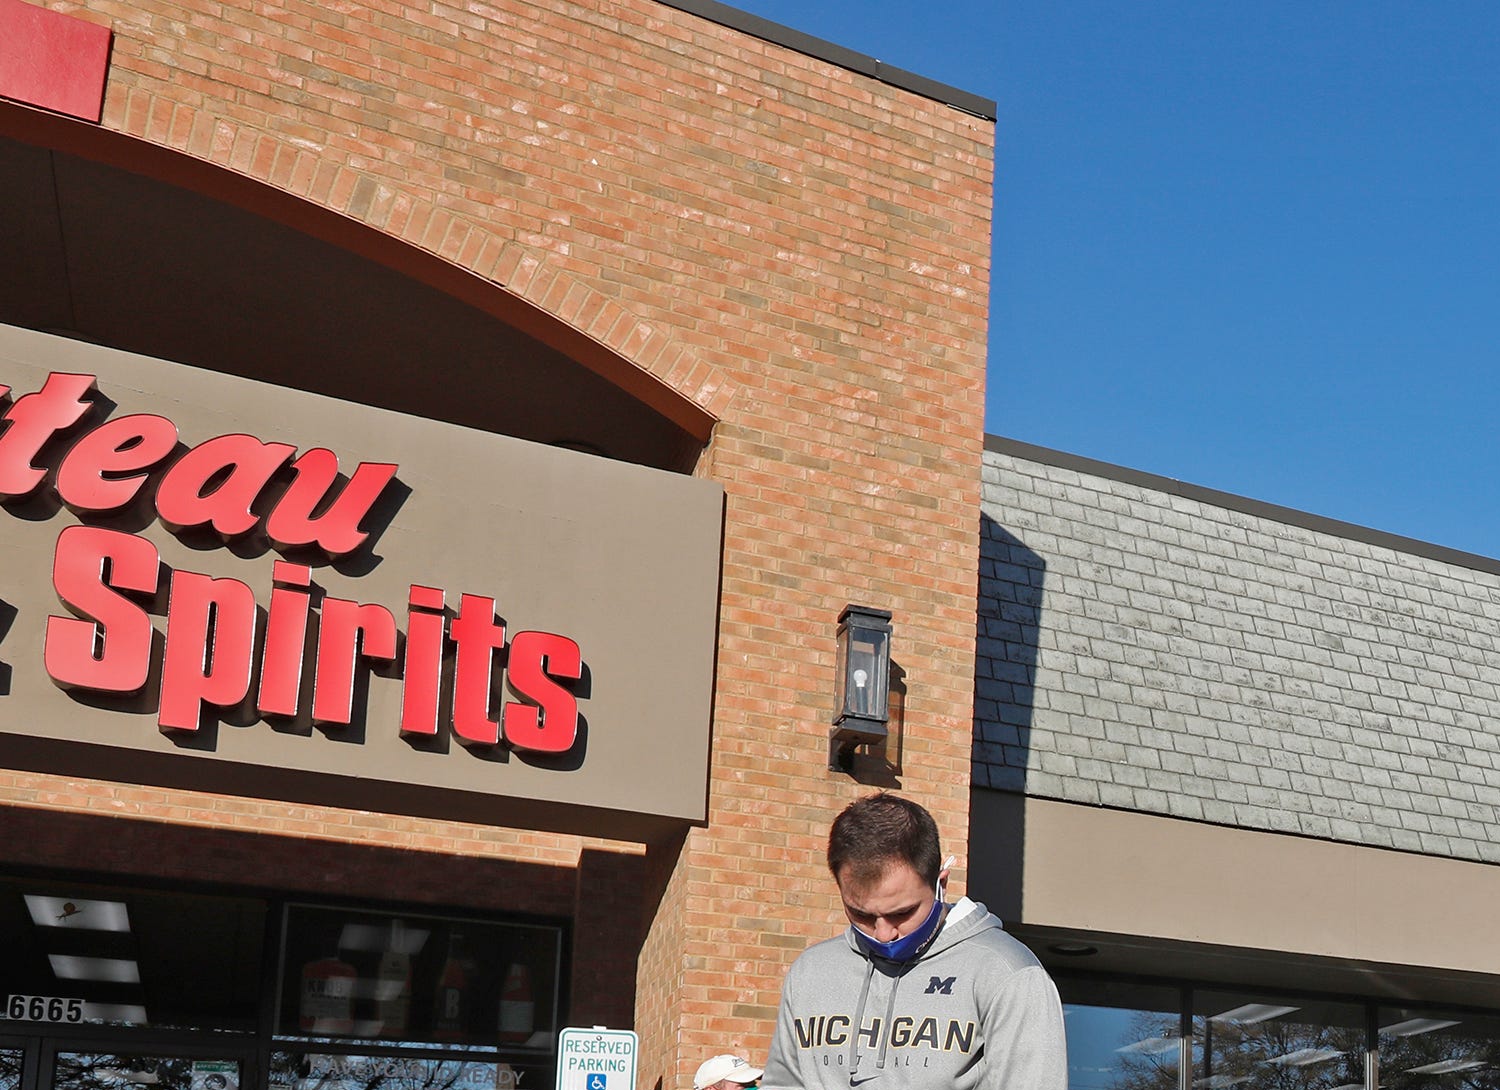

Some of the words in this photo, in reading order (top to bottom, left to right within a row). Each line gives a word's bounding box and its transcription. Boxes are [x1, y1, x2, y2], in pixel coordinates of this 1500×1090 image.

[0, 372, 398, 553] teau
[44, 525, 582, 752] Spirits
[924, 976, 956, 994] M
[9, 995, 82, 1022] 6665
[565, 1039, 632, 1055] RESERVED
[794, 1015, 975, 1054] MICHGAN
[309, 1058, 366, 1076] HAVE
[371, 1061, 427, 1079] YOUR
[457, 1068, 525, 1086] READY
[569, 1058, 626, 1072] PARKING
[813, 1054, 929, 1068] OOTALL
